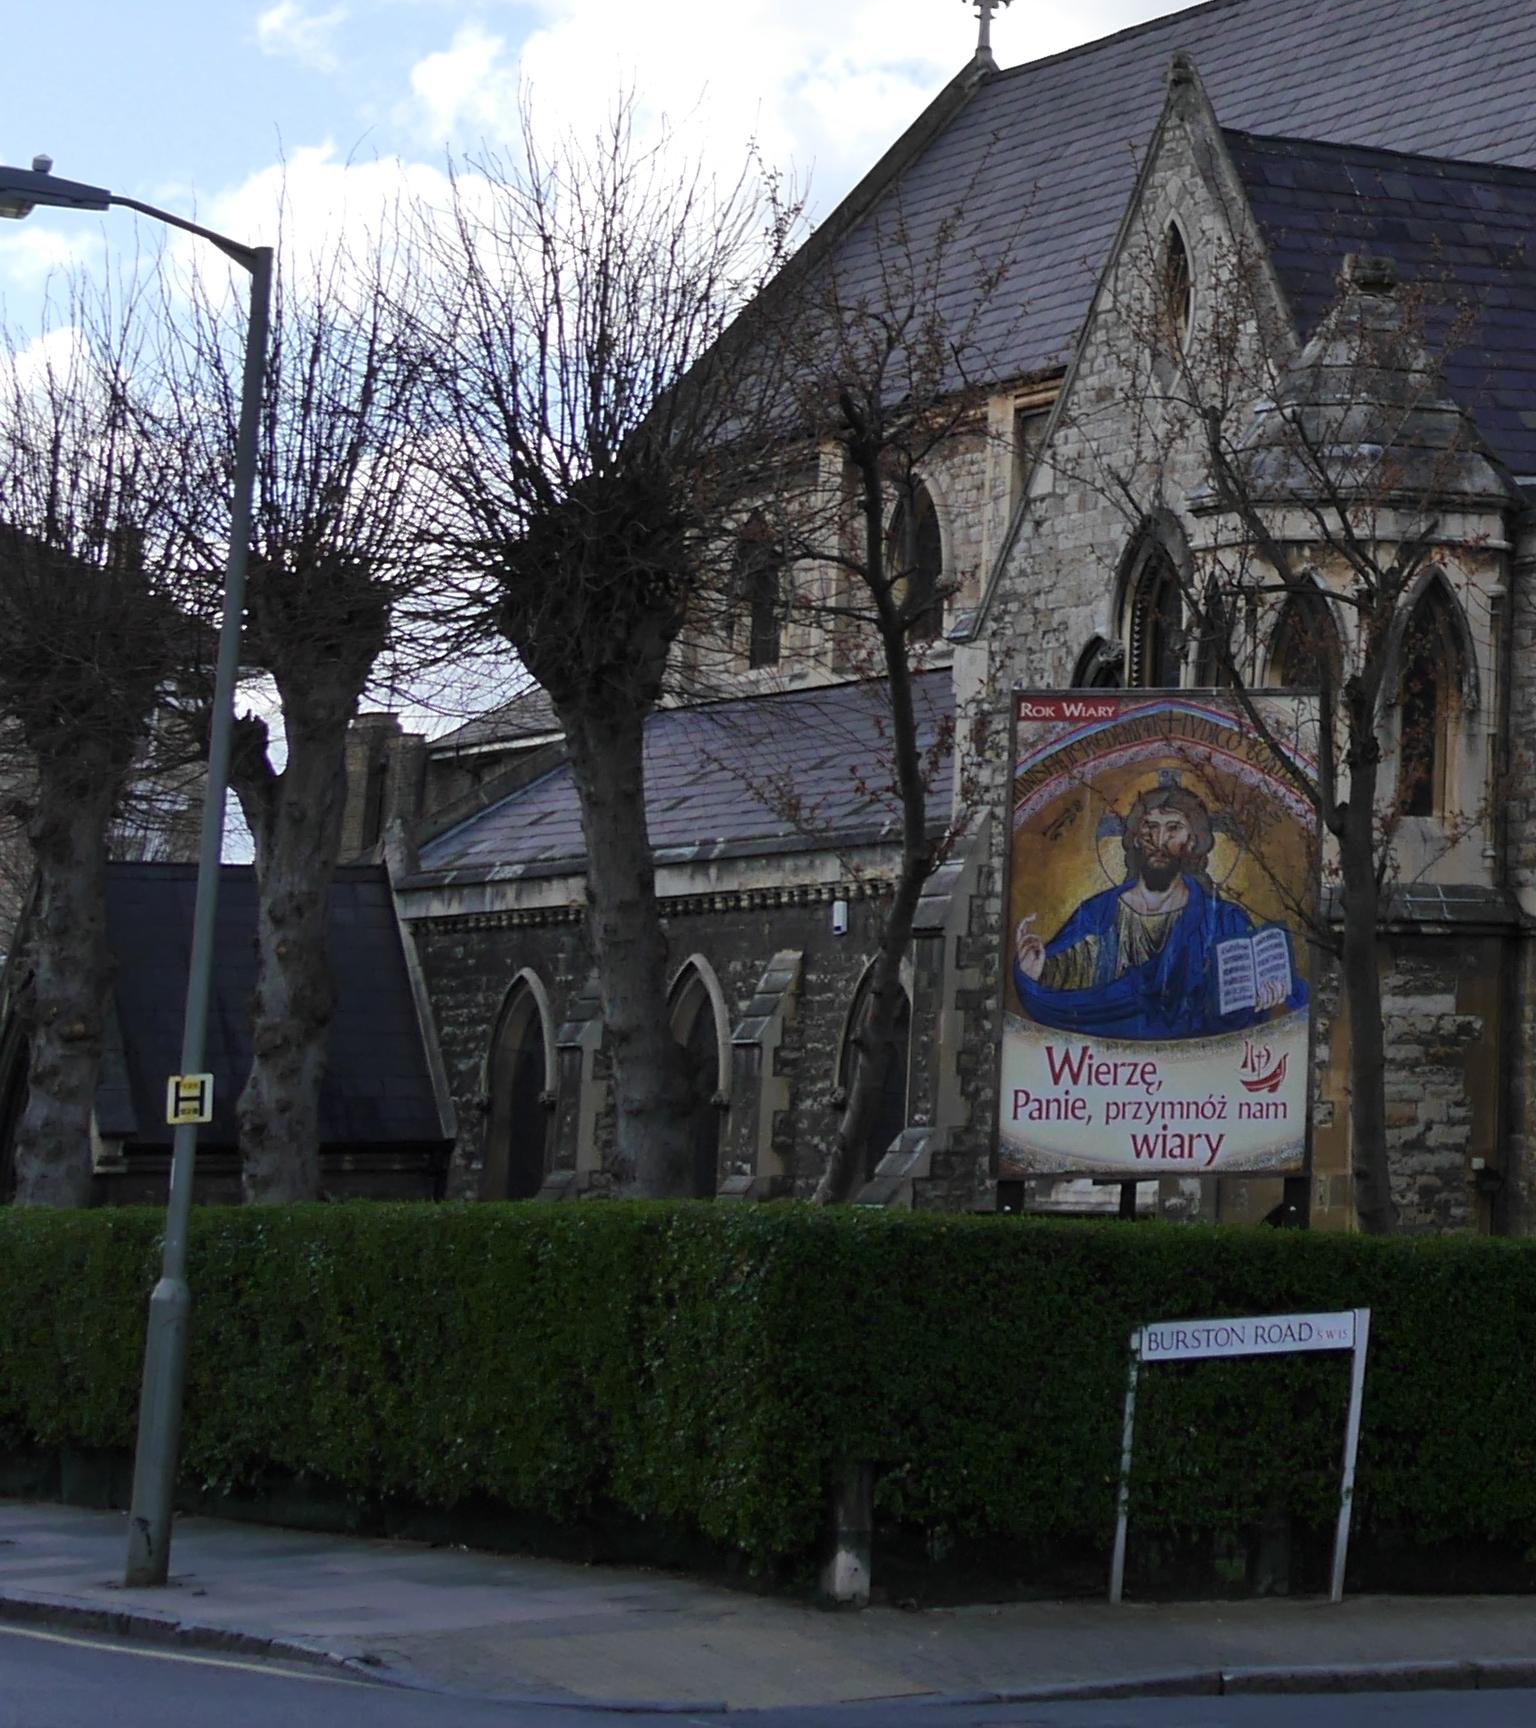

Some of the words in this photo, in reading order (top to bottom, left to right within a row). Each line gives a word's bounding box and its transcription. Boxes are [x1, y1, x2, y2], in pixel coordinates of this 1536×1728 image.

[1045, 1045, 1163, 1095] Wierzę,
[173, 1080, 206, 1119] H
[1012, 1089, 1093, 1125] Panie,
[1104, 1094, 1228, 1125] przymnóż
[1238, 1100, 1288, 1120] nam
[1130, 1123, 1226, 1166] wiary
[1147, 1327, 1246, 1351] BURSTON
[1254, 1322, 1313, 1345] ROAD
